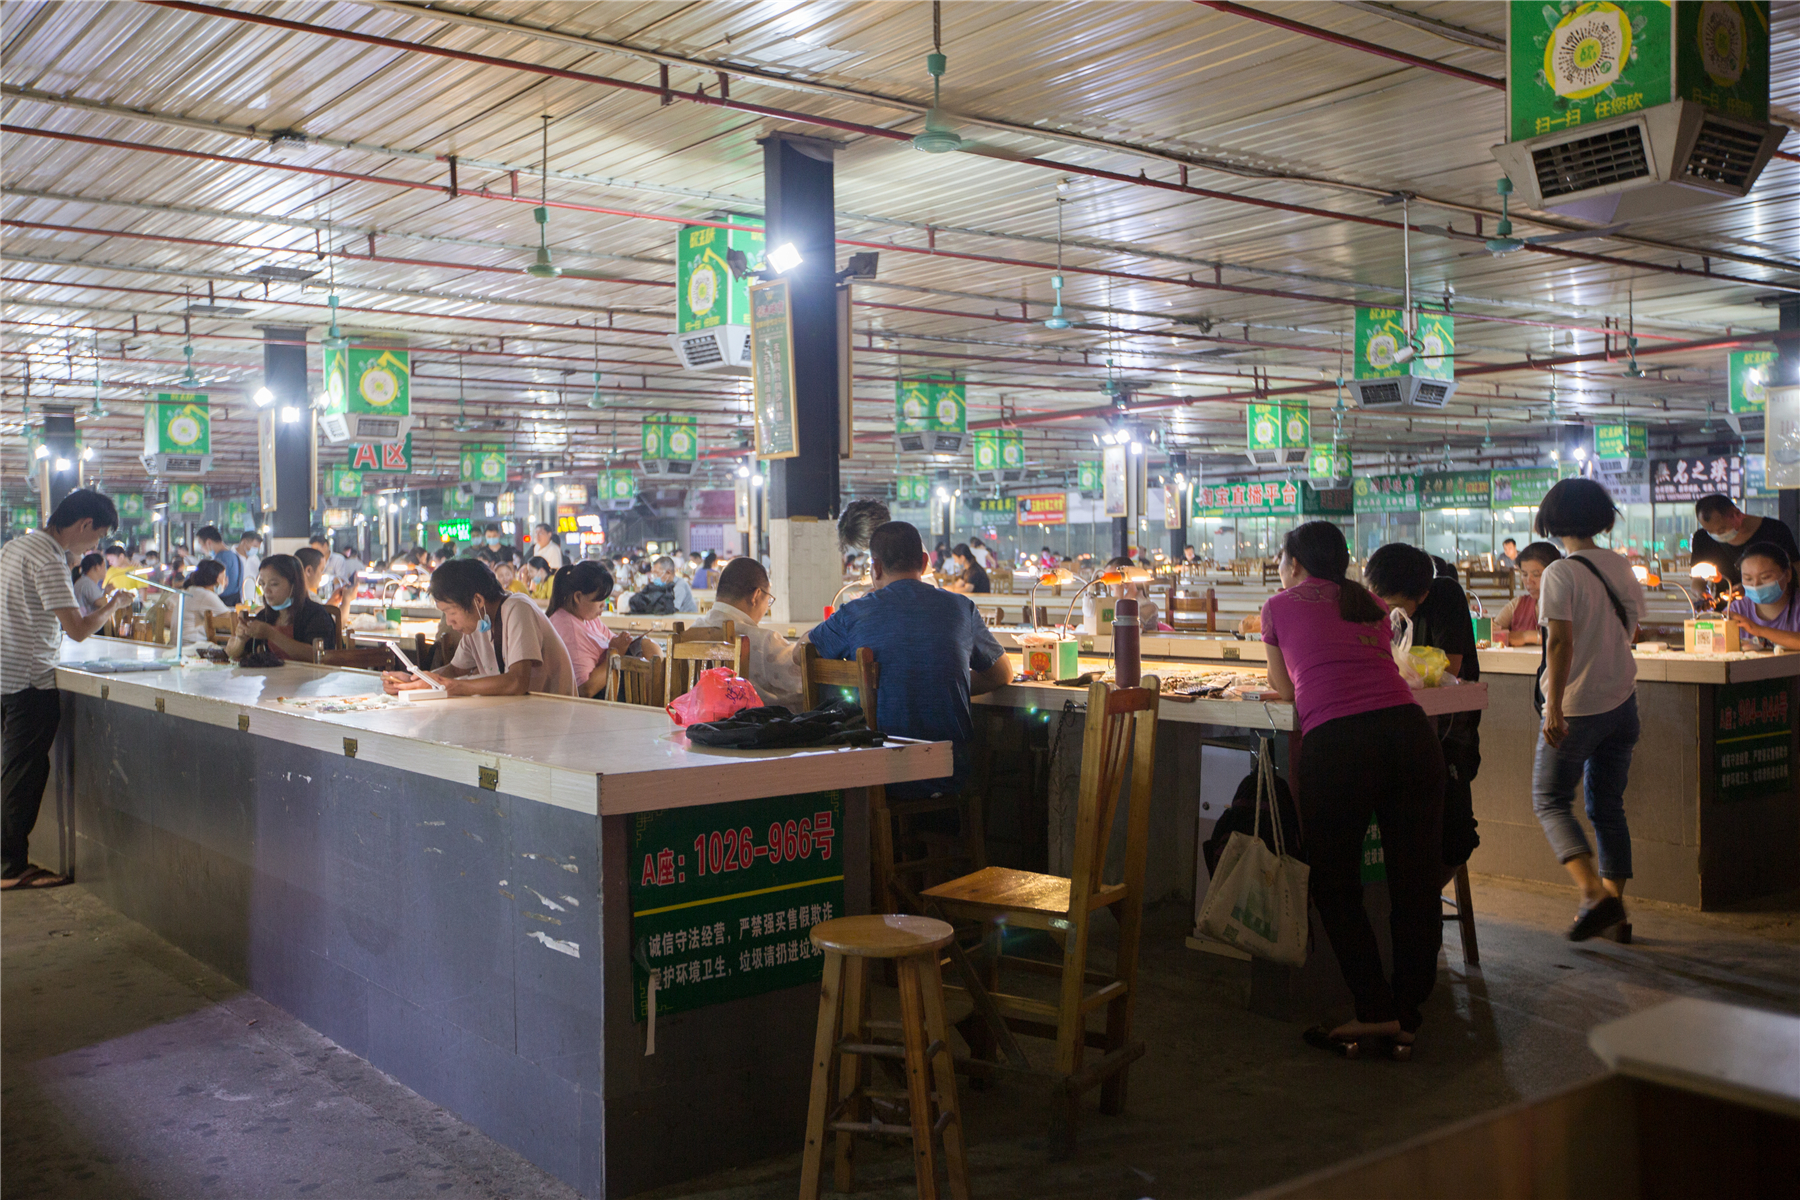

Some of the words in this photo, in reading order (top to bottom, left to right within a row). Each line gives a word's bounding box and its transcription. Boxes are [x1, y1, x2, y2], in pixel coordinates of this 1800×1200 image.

[1535, 108, 1581, 135] 扫一扫
[1594, 92, 1643, 120] 任您砍
[352, 438, 408, 470] A区
[1200, 482, 1298, 508] 淘宝直播平台
[641, 811, 835, 886] A座：1026-966号
